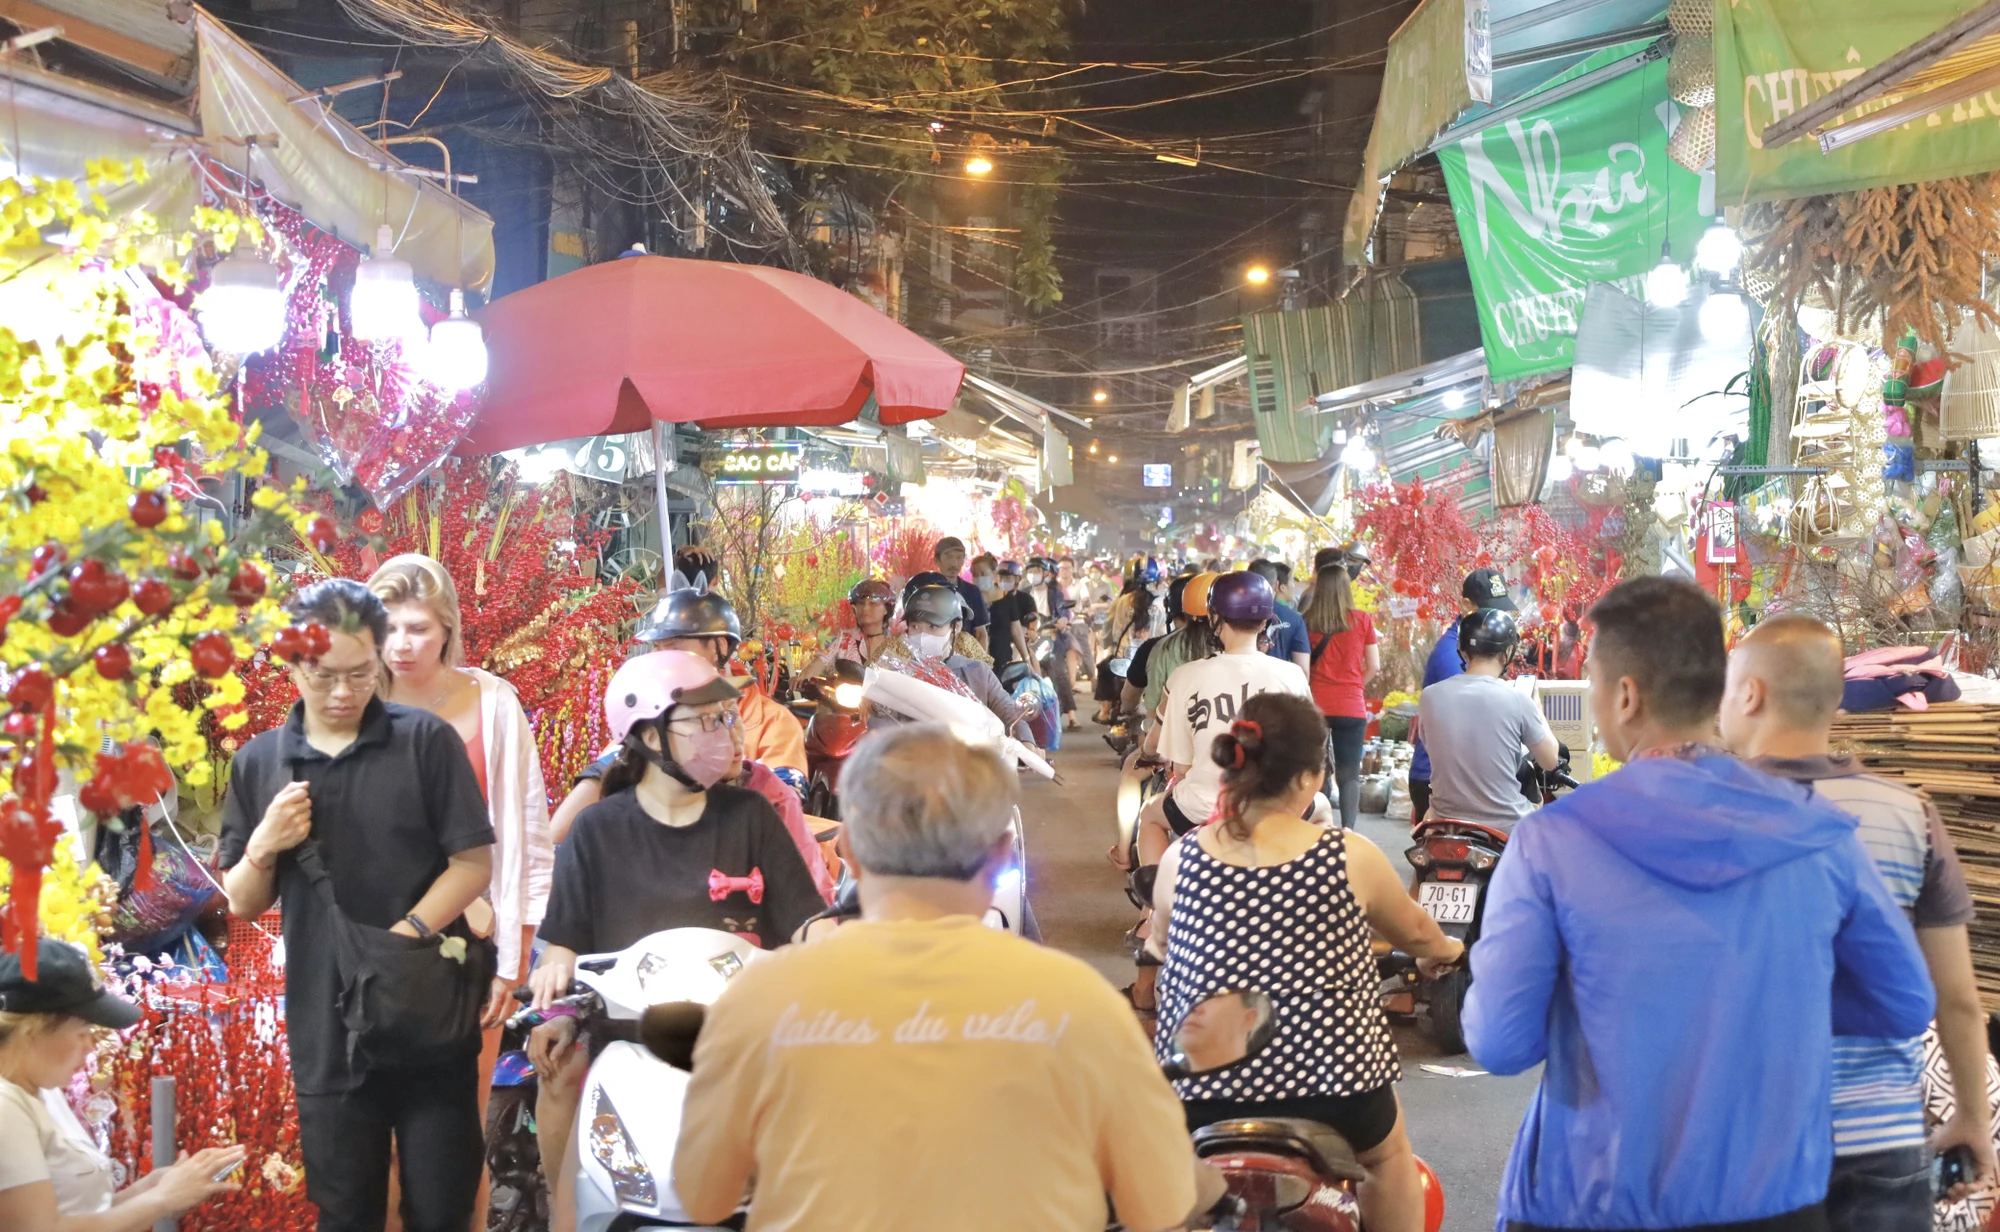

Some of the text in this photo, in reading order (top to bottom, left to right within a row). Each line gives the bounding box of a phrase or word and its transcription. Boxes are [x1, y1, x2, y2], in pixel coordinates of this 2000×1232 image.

[1460, 116, 1647, 261] Như
[765, 1001, 880, 1072] faites
[893, 999, 949, 1043] du
